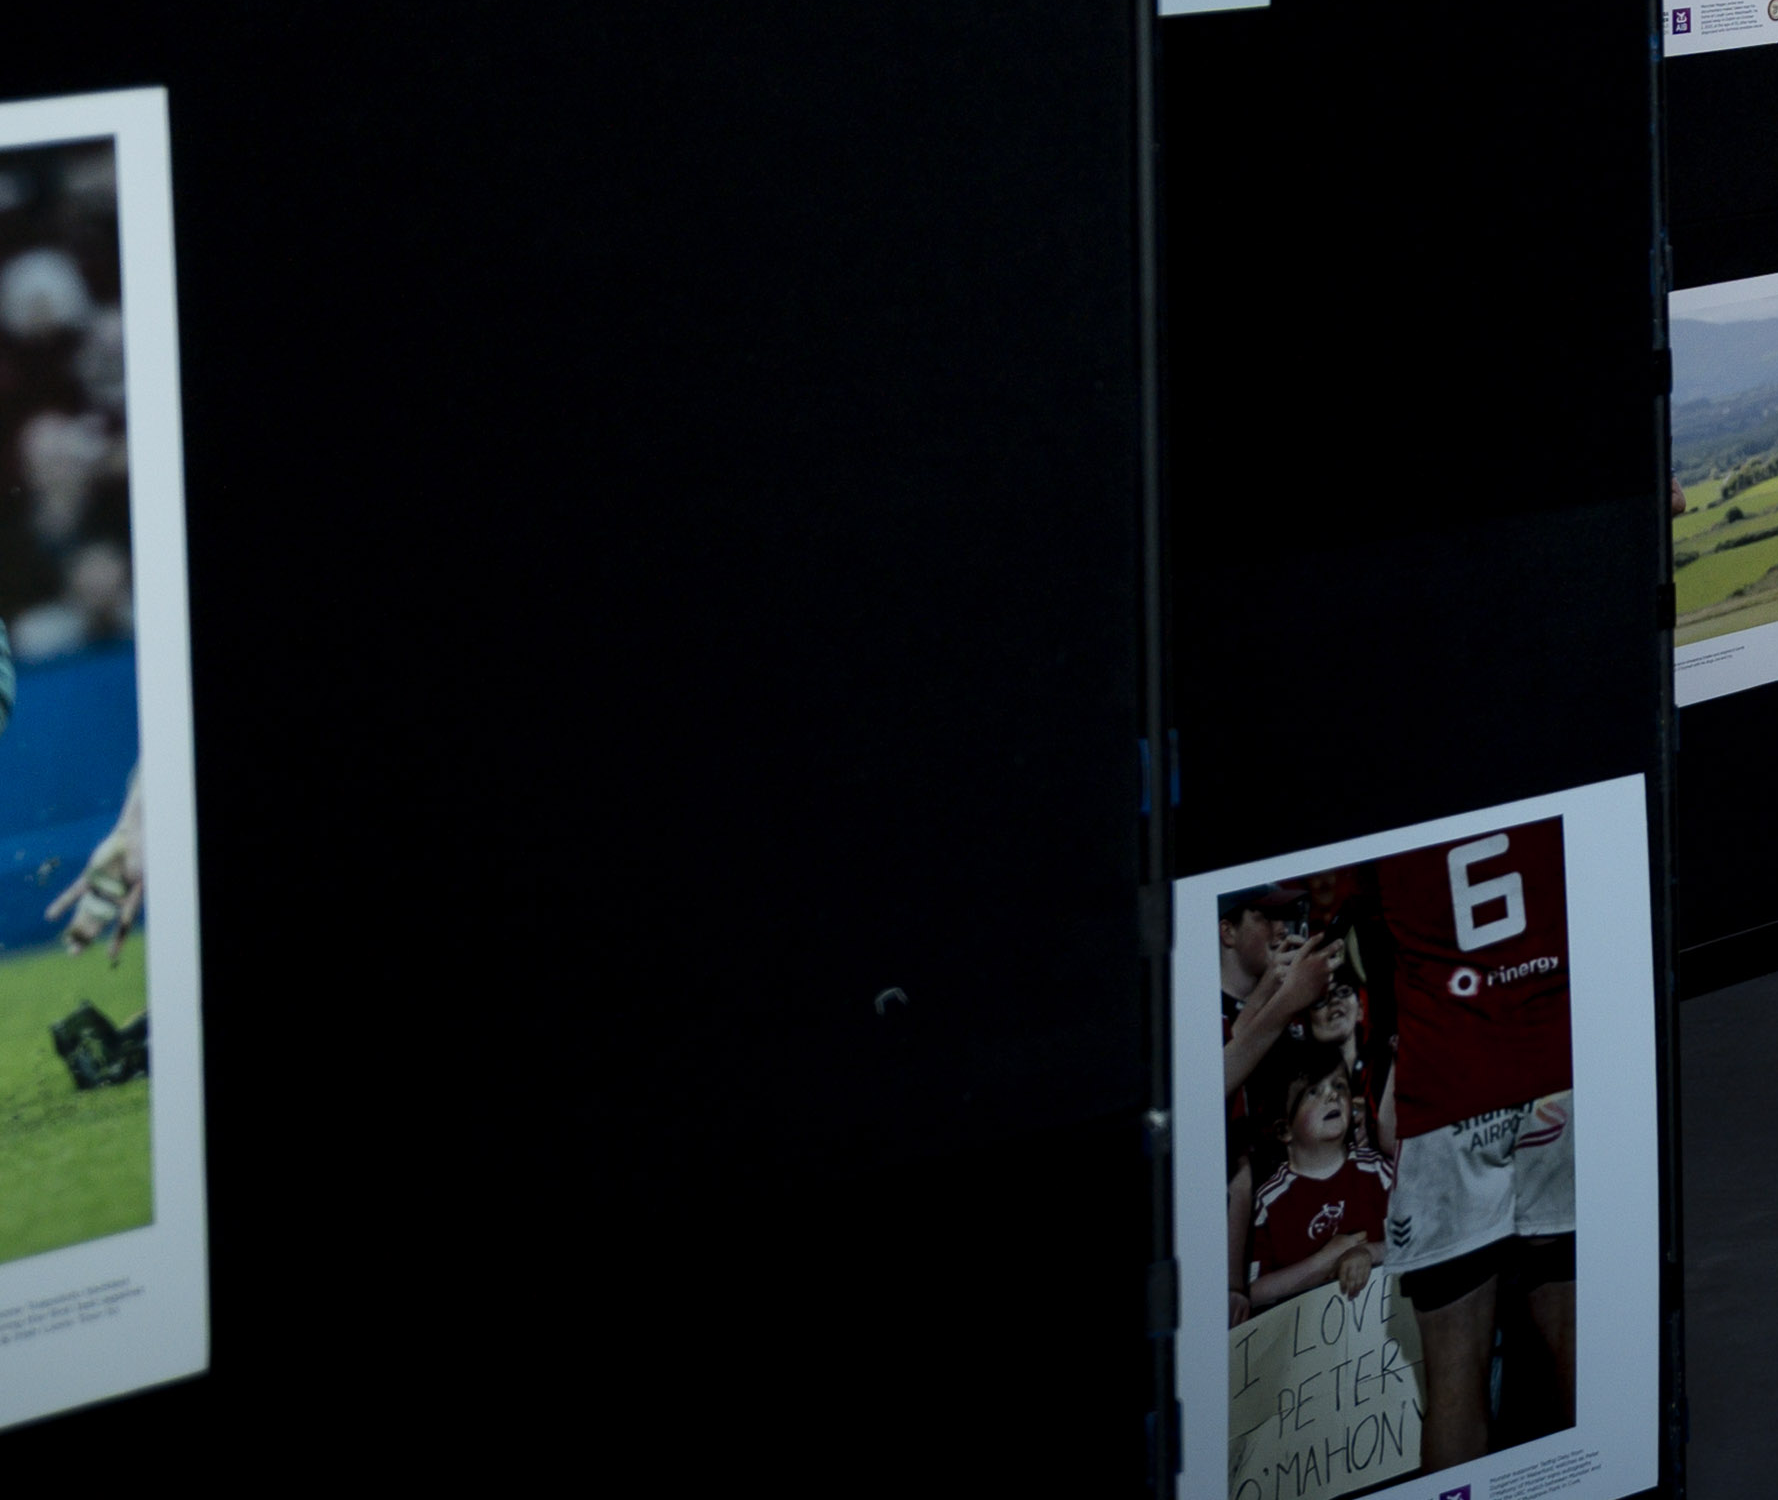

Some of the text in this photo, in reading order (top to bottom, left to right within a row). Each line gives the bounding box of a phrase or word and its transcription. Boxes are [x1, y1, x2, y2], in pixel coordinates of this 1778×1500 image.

[1446, 832, 1527, 952] 6
[1487, 955, 1559, 988] Pinergy
[1233, 1274, 1398, 1399] I LOVE
[1278, 1337, 1404, 1439] PETER
